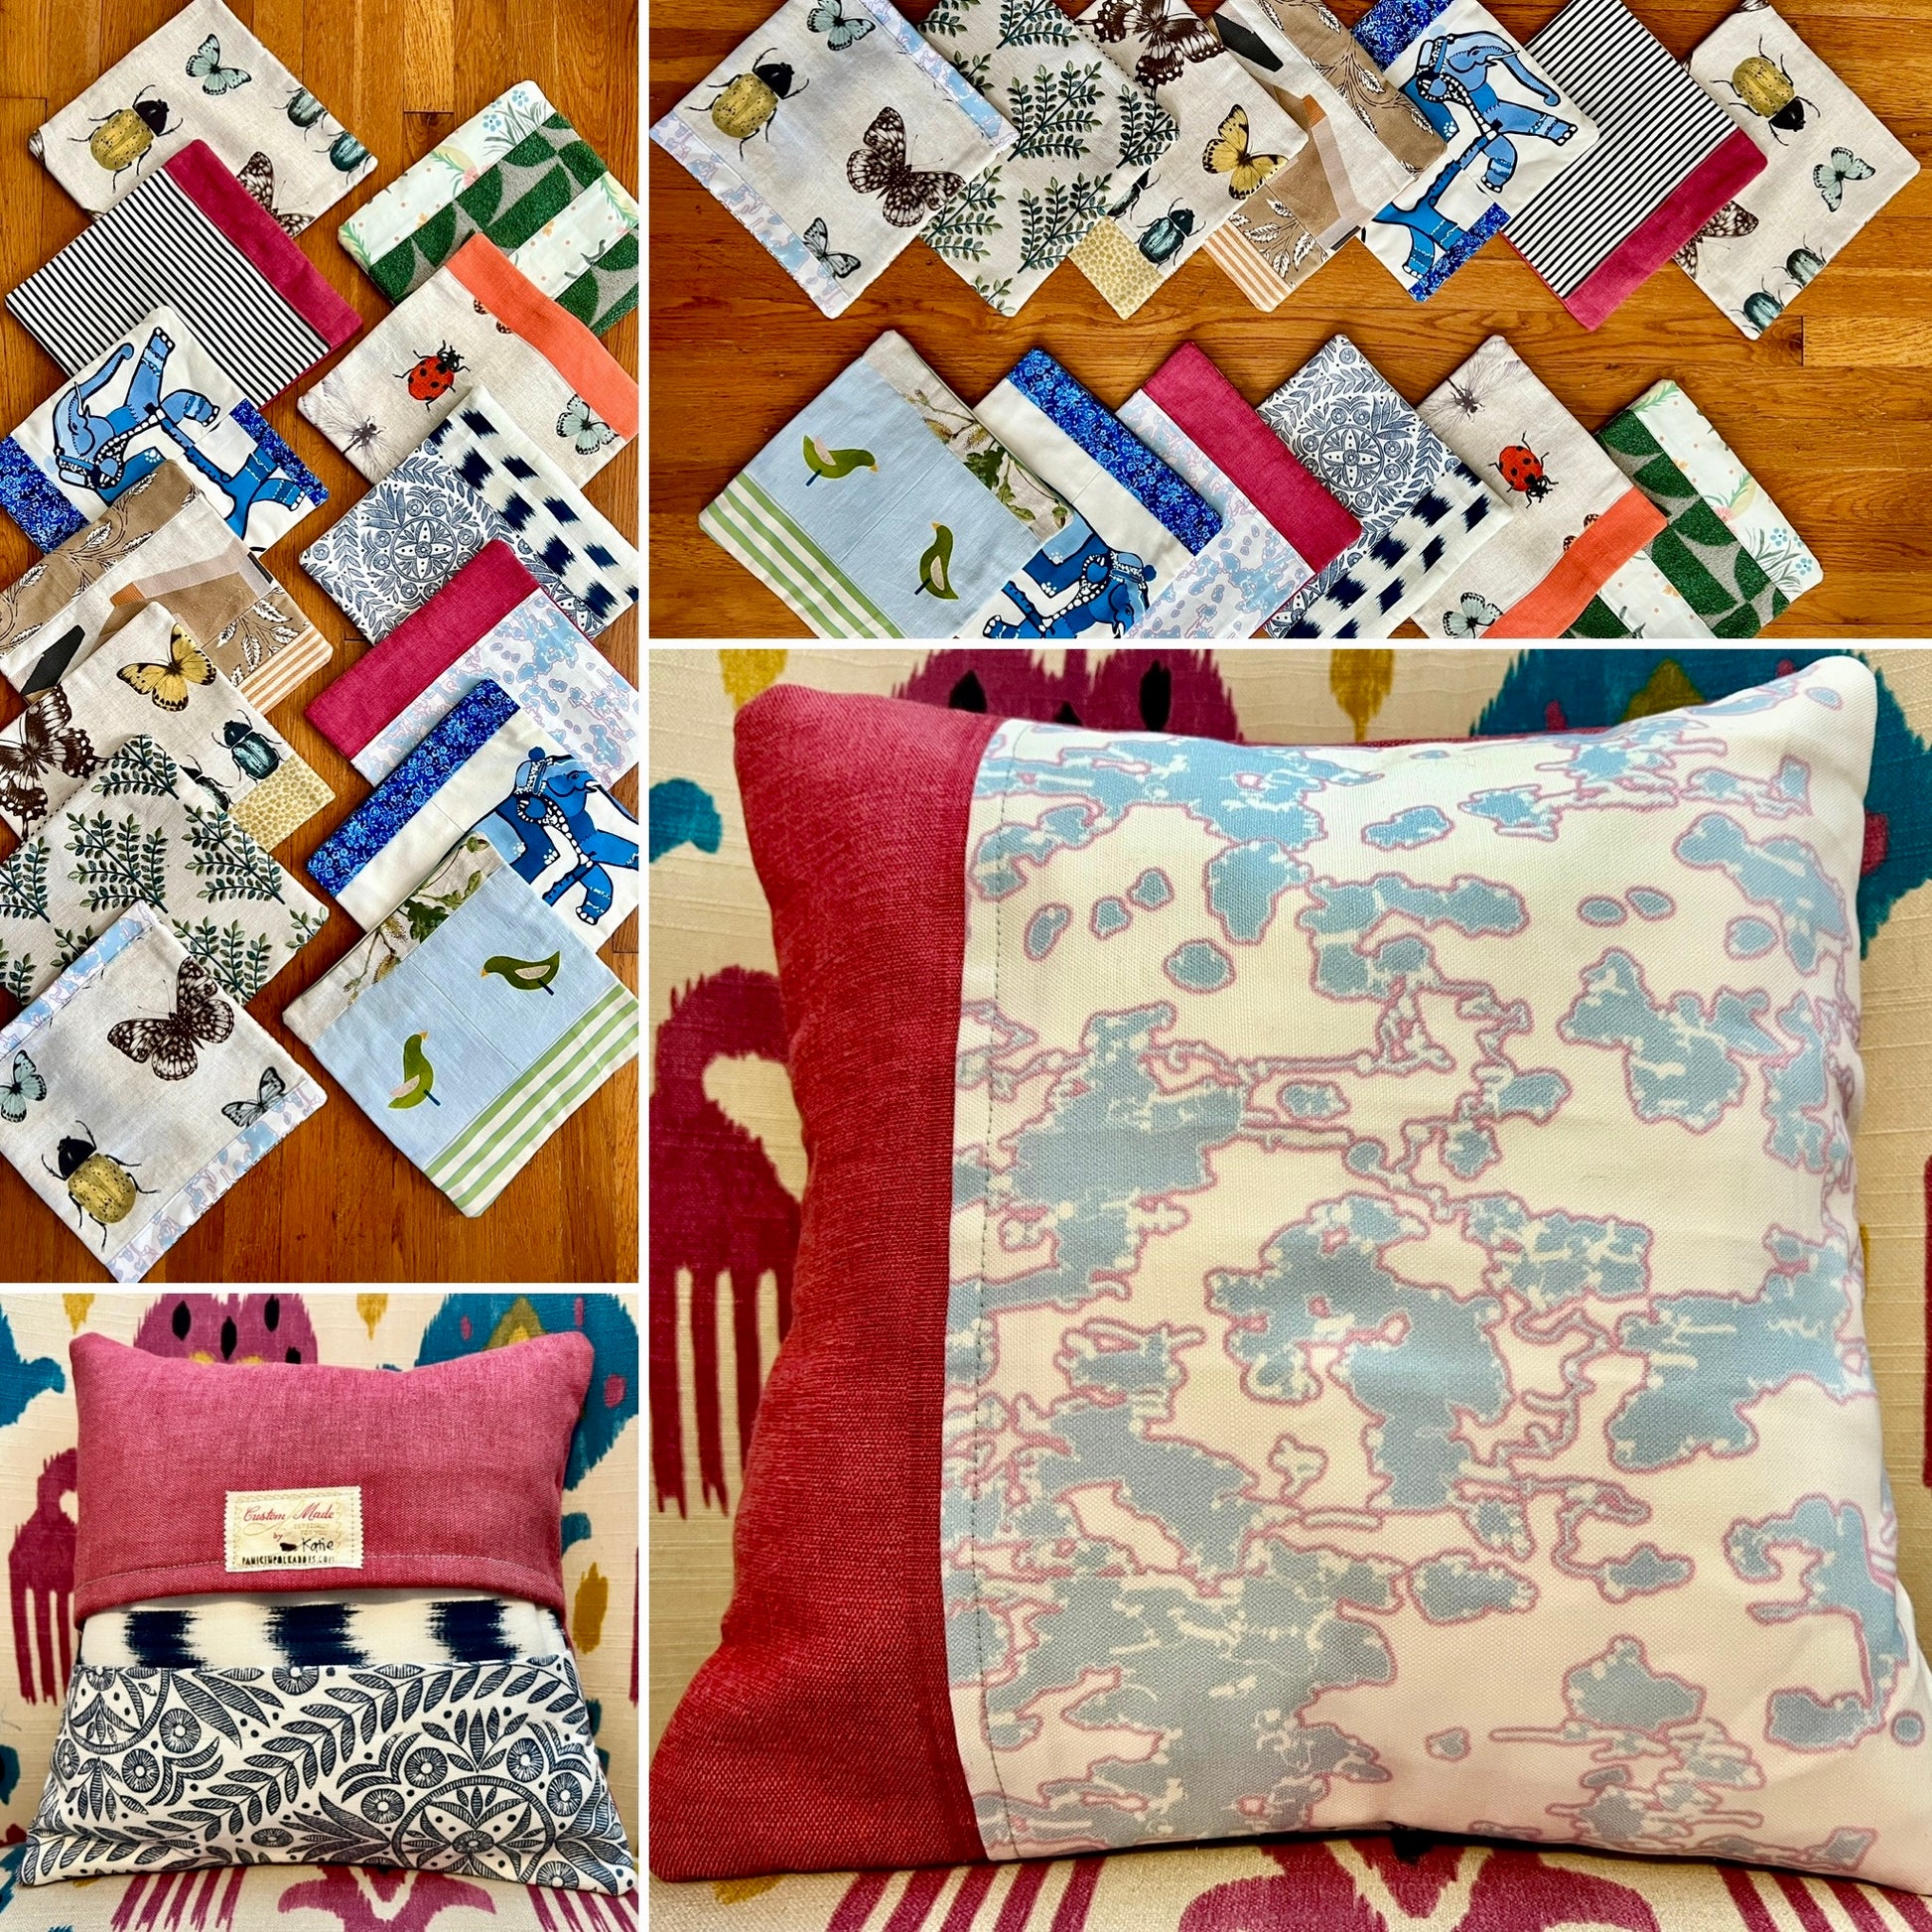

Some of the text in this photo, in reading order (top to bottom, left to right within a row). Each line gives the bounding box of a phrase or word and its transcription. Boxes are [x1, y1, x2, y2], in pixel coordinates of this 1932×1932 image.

[243, 1502, 335, 1522] Custom Made
[273, 1532, 283, 1542] by
[301, 1537, 335, 1553] Katie
